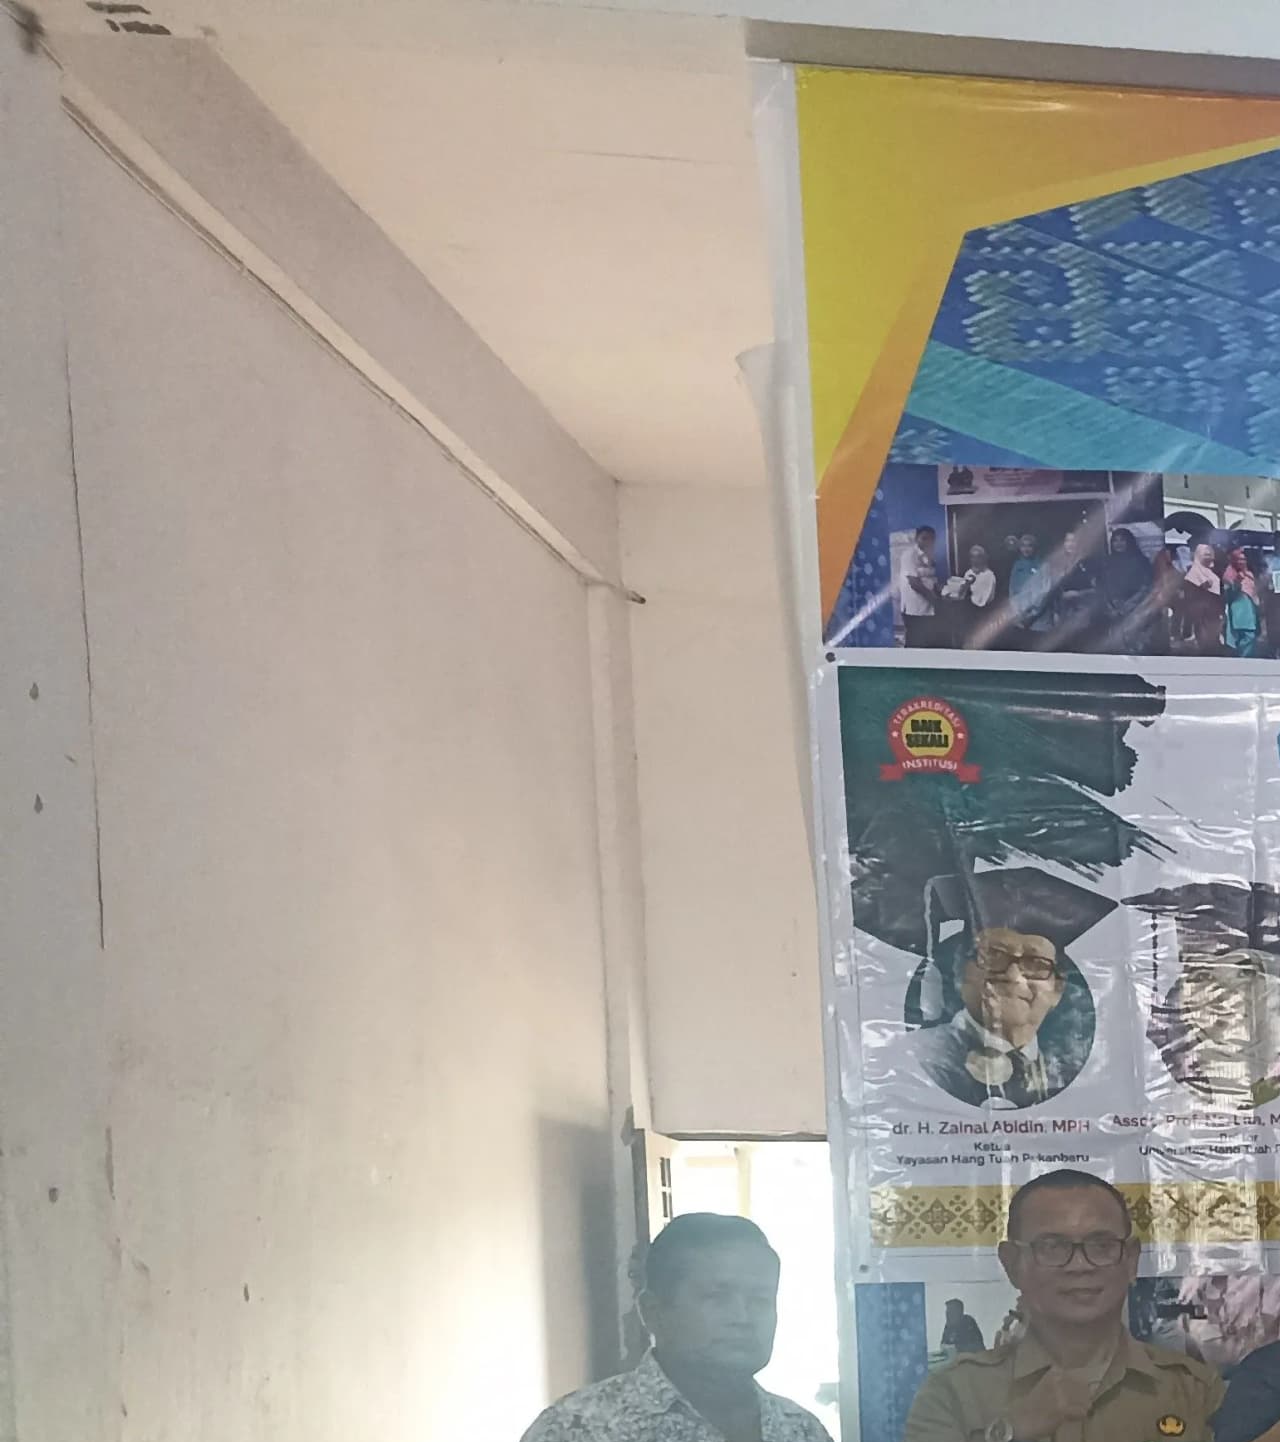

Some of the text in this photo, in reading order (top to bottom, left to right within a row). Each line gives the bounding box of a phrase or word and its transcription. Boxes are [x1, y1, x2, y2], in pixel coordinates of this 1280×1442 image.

[901, 758, 958, 771] INSTITUSI
[938, 1120, 989, 1135] Zainal
[1052, 1119, 1090, 1134] MPH
[896, 1155, 948, 1167] Yayasan
[951, 1154, 985, 1166] Hang
[989, 1154, 1019, 1164] Tuh
